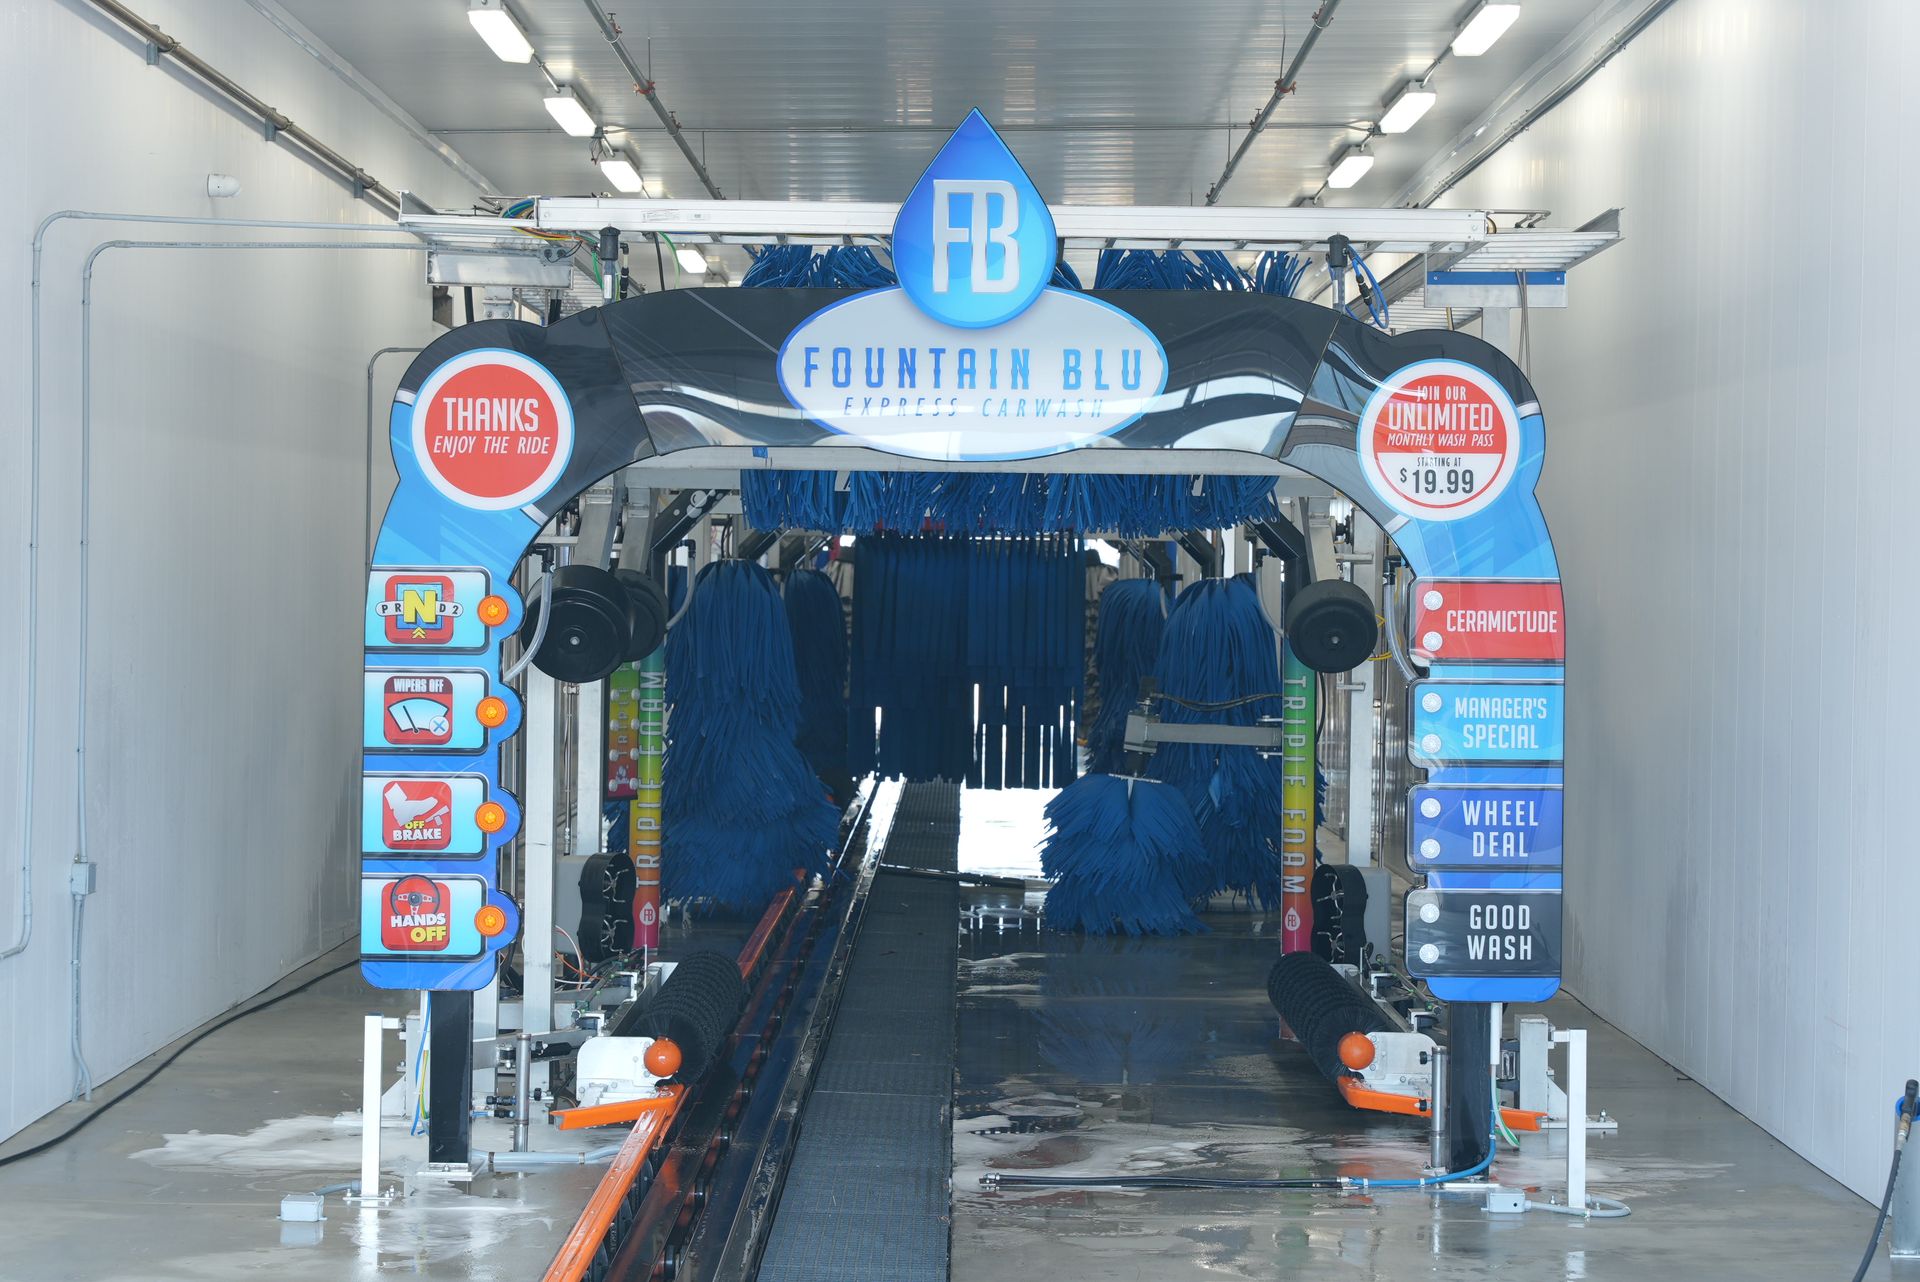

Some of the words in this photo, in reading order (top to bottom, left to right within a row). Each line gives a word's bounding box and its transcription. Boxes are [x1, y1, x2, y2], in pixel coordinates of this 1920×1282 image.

[932, 179, 1020, 293] FB
[803, 346, 1030, 390] FOUNTAIN
[1062, 348, 1142, 391] BLU
[1416, 385, 1440, 402] JOIN
[1445, 385, 1467, 401] OUR
[443, 397, 539, 431] THANKS
[843, 397, 958, 417] EXPRESS
[982, 398, 1103, 418] CARWASH
[1388, 402, 1494, 431] UNLIMITED
[433, 436, 476, 457] ENJOY
[483, 436, 509, 454] THE
[517, 437, 550, 455] RIDE
[1387, 433, 1434, 446] MONTHLY
[1438, 433, 1466, 447] WASH
[1471, 434, 1494, 447] PASS
[1417, 457, 1450, 467] STARTING
[1454, 457, 1462, 467] AT
[1400, 467, 1474, 494] $19.99
[403, 590, 438, 624] N
[1446, 610, 1557, 633] CERAMICTUDE
[393, 678, 426, 693] WIPERS
[428, 679, 444, 692] OFF
[639, 671, 663, 756] FOAM
[1455, 696, 1547, 719] MANAGER'S
[1463, 724, 1539, 749] SPECIAL
[404, 820, 425, 830] OFF
[1462, 800, 1539, 826] WHEEL
[392, 828, 442, 841] BRAKE
[1472, 831, 1528, 857] DEAL
[1282, 809, 1306, 893] FOAM
[390, 913, 446, 928] HANDS
[1469, 904, 1530, 930] GOOD
[410, 926, 447, 943] OFF
[1467, 935, 1532, 960] WASH
